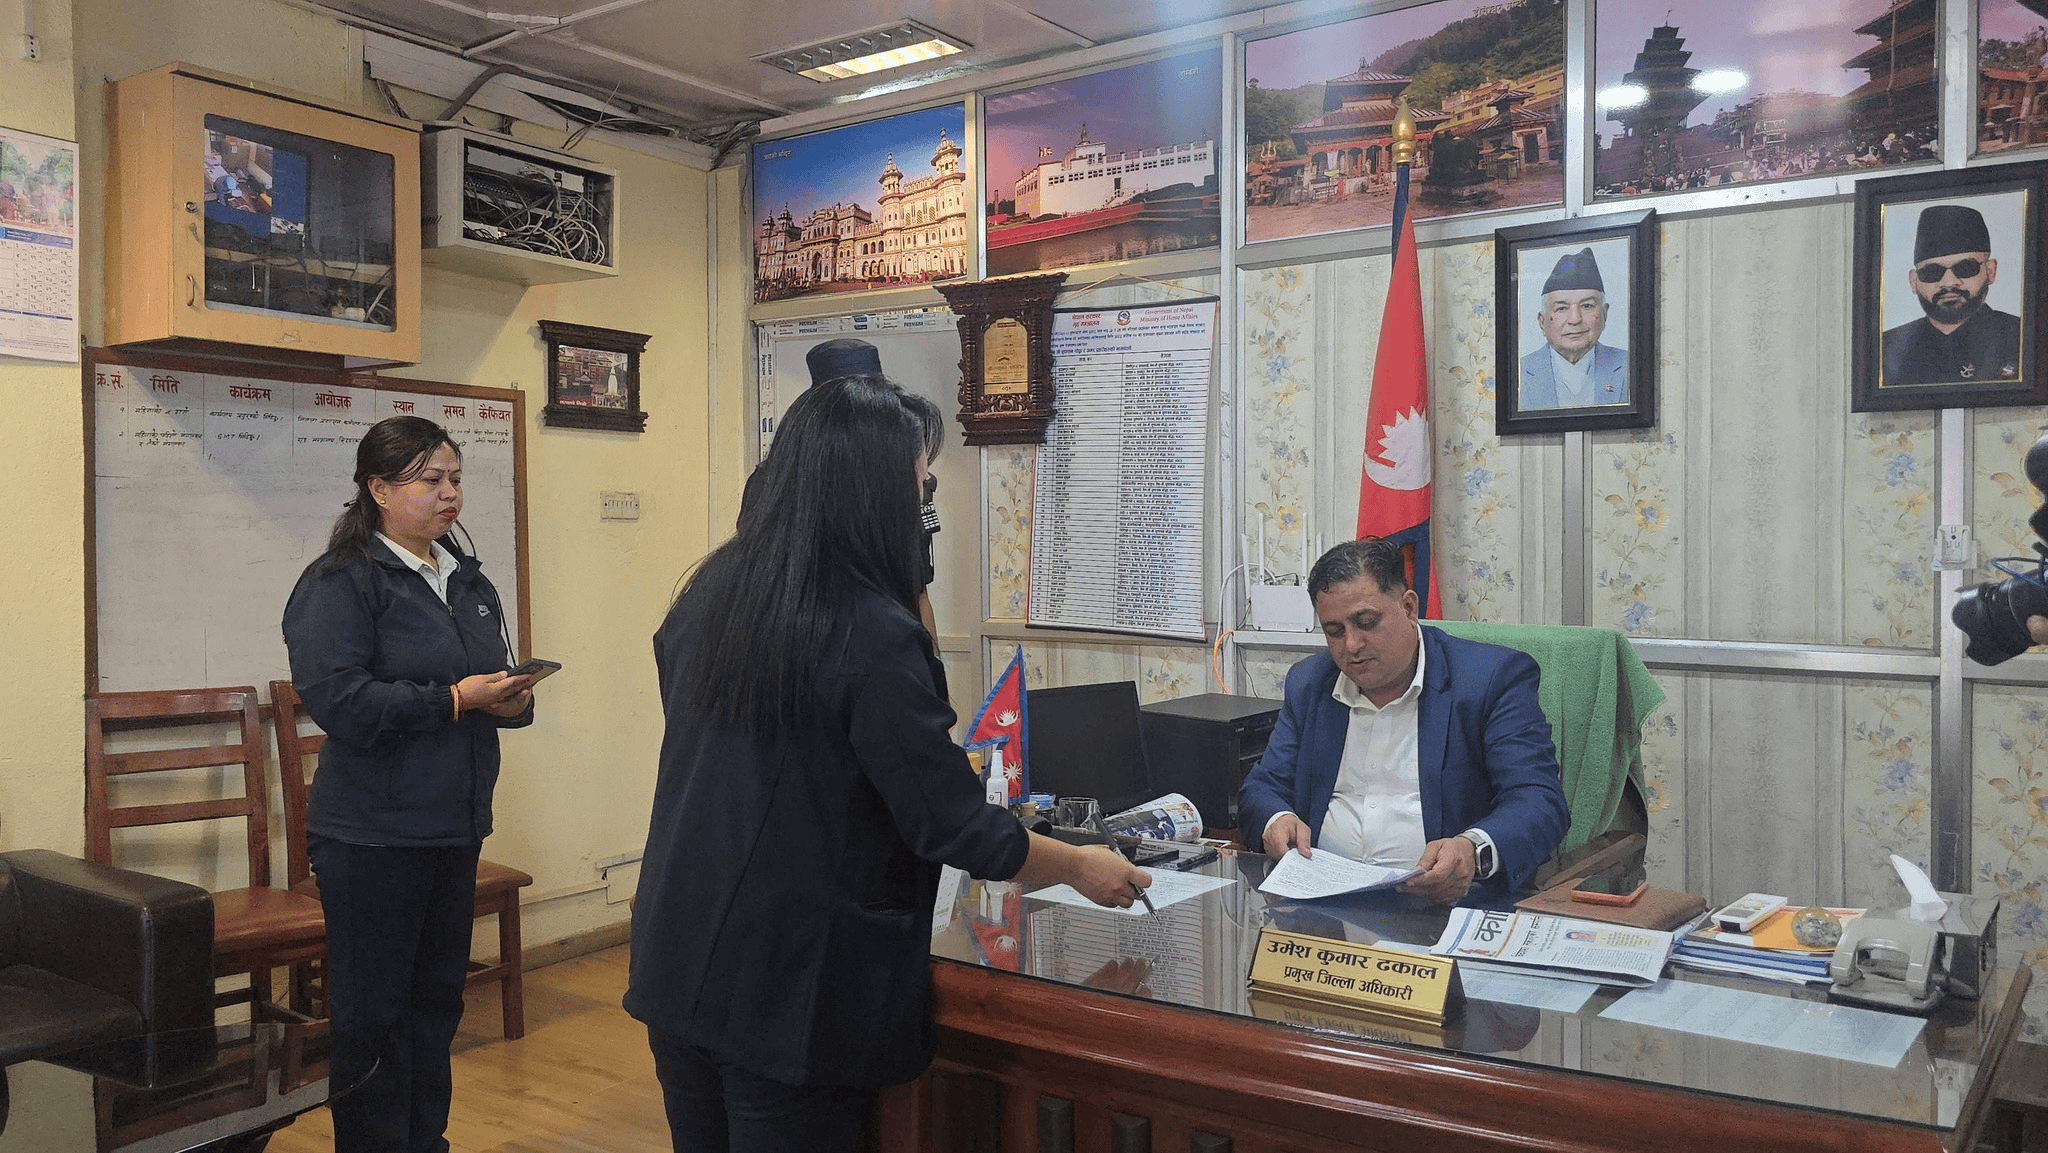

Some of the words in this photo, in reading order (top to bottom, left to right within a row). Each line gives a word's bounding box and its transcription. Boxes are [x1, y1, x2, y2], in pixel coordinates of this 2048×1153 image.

[1139, 315, 1160, 324] Ministry
[1180, 313, 1199, 321] Affairs
[1144, 308, 1173, 316] Government
[1179, 306, 1194, 314] Nepal
[149, 374, 181, 394] मिति
[314, 390, 353, 409] आयोजक
[392, 399, 415, 415] स्थान
[442, 404, 467, 419] समय
[478, 403, 513, 422] कैफियत
[1266, 939, 1313, 960] उमेश
[1316, 948, 1372, 970] कुमार
[1376, 956, 1439, 980] ढकाल
[1283, 966, 1315, 983] प्रमुख
[1316, 968, 1356, 990] जिल्ला
[1358, 979, 1414, 1001] अधिकारी
